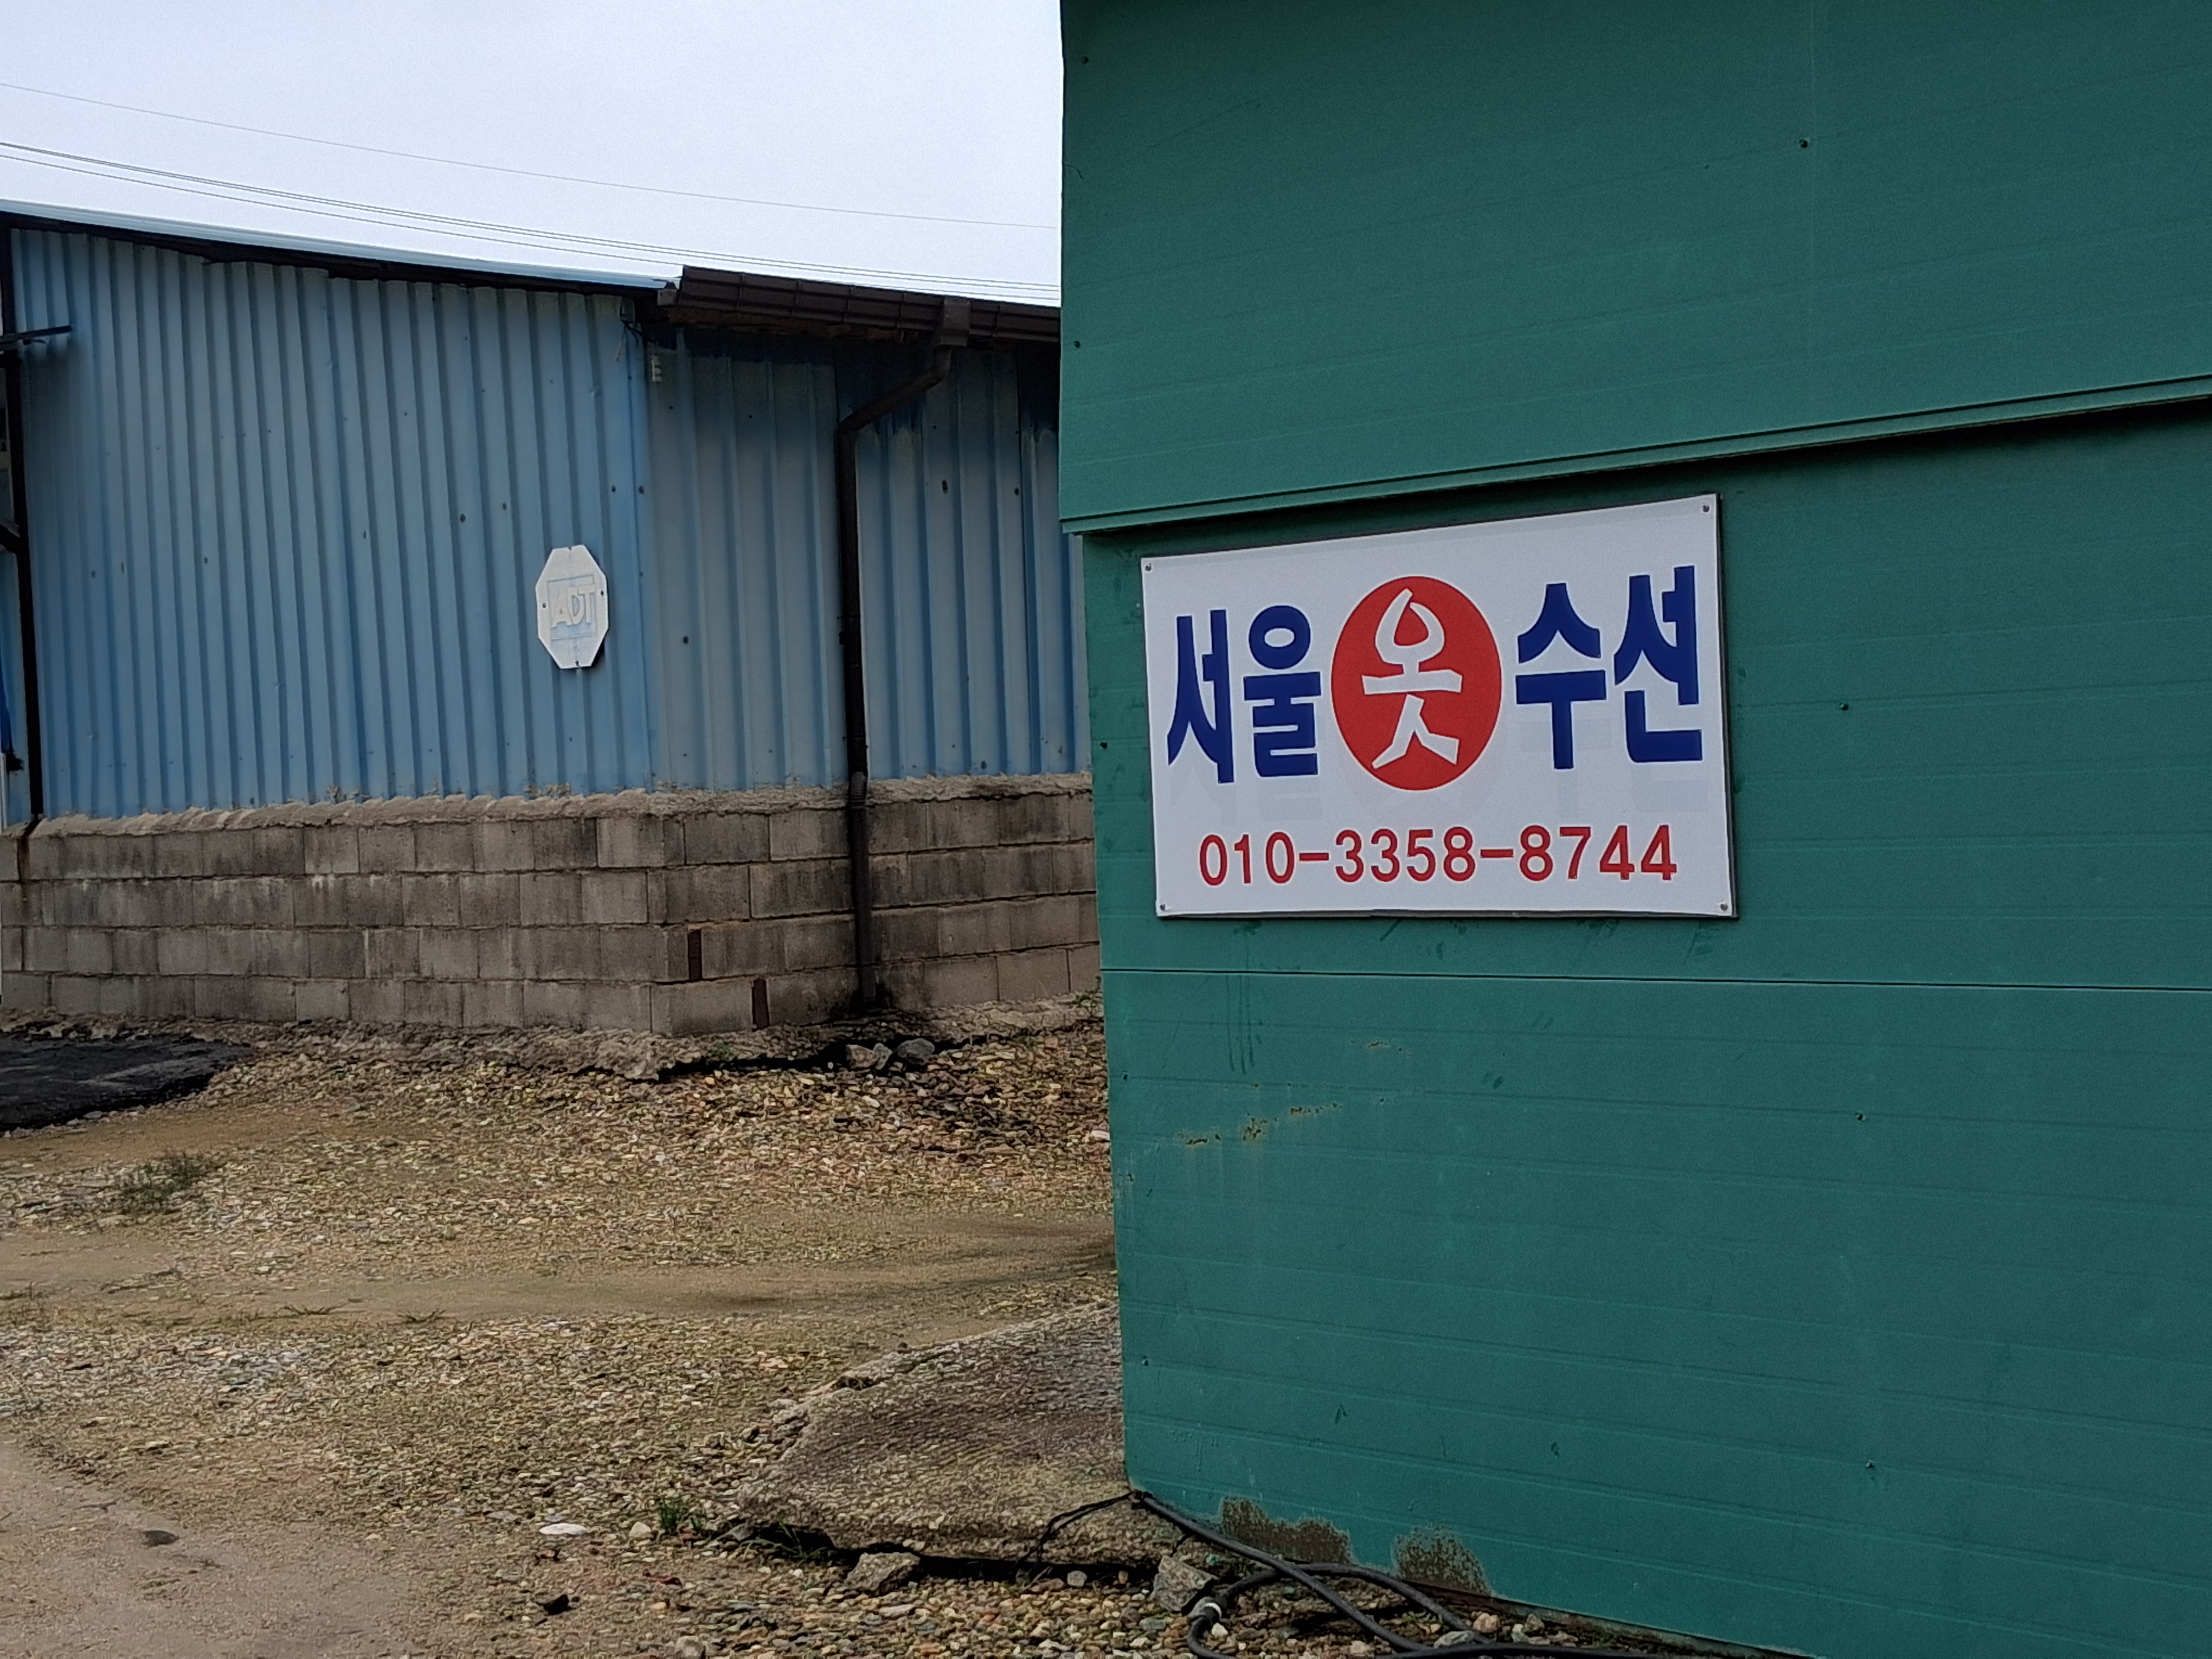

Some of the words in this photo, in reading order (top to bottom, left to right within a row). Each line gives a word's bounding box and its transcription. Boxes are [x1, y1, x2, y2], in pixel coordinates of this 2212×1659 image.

[550, 583, 595, 628] ADT
[1166, 605, 1322, 785] 서울
[1361, 588, 1463, 769] 옷
[1515, 565, 1704, 770] 수선
[1199, 825, 1677, 886] 010-3358-8744
